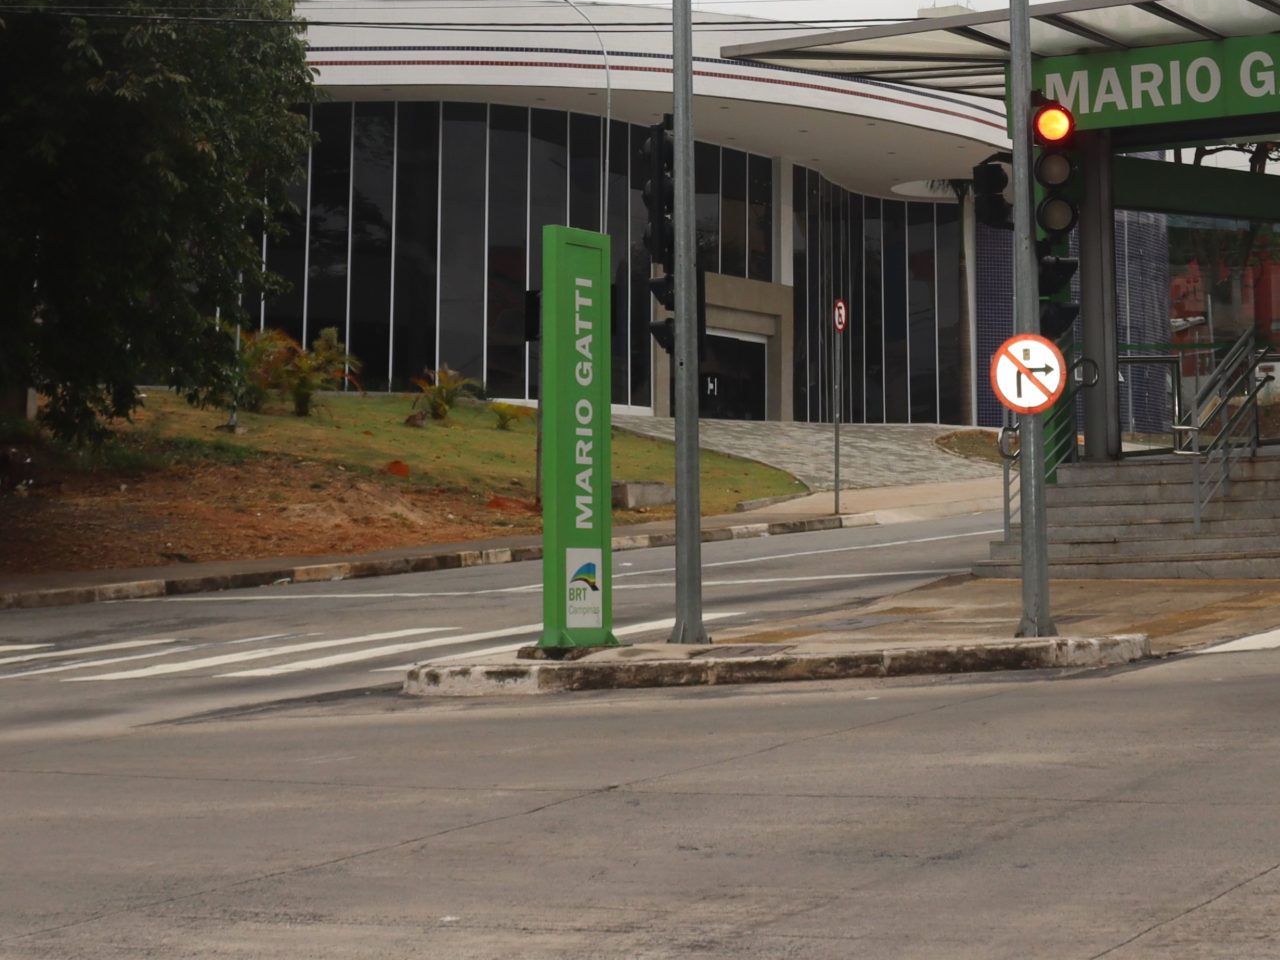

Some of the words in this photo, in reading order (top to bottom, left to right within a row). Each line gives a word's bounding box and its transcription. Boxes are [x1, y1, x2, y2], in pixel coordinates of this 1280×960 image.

[1045, 56, 1222, 115] MARIO
[574, 277, 593, 387] GATTI
[575, 399, 593, 530] MARIO
[568, 587, 588, 601] BRT
